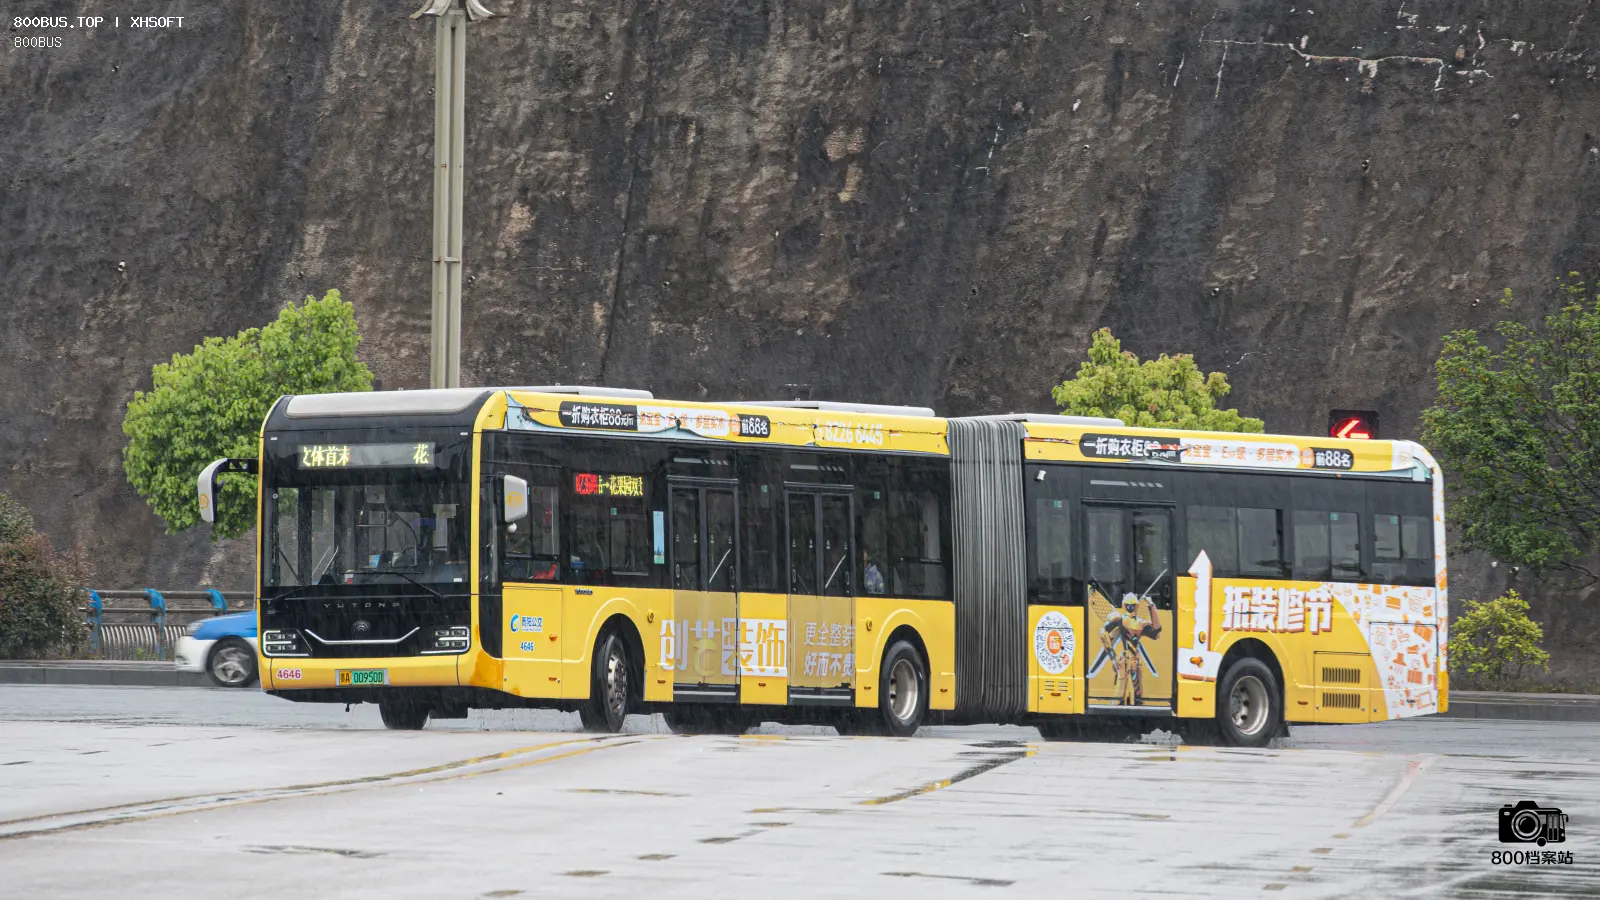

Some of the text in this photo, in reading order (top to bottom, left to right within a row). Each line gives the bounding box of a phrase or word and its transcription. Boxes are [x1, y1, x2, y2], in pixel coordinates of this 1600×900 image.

[413, 443, 428, 464] 花
[520, 641, 535, 652] 4646
[276, 669, 302, 680] 4646
